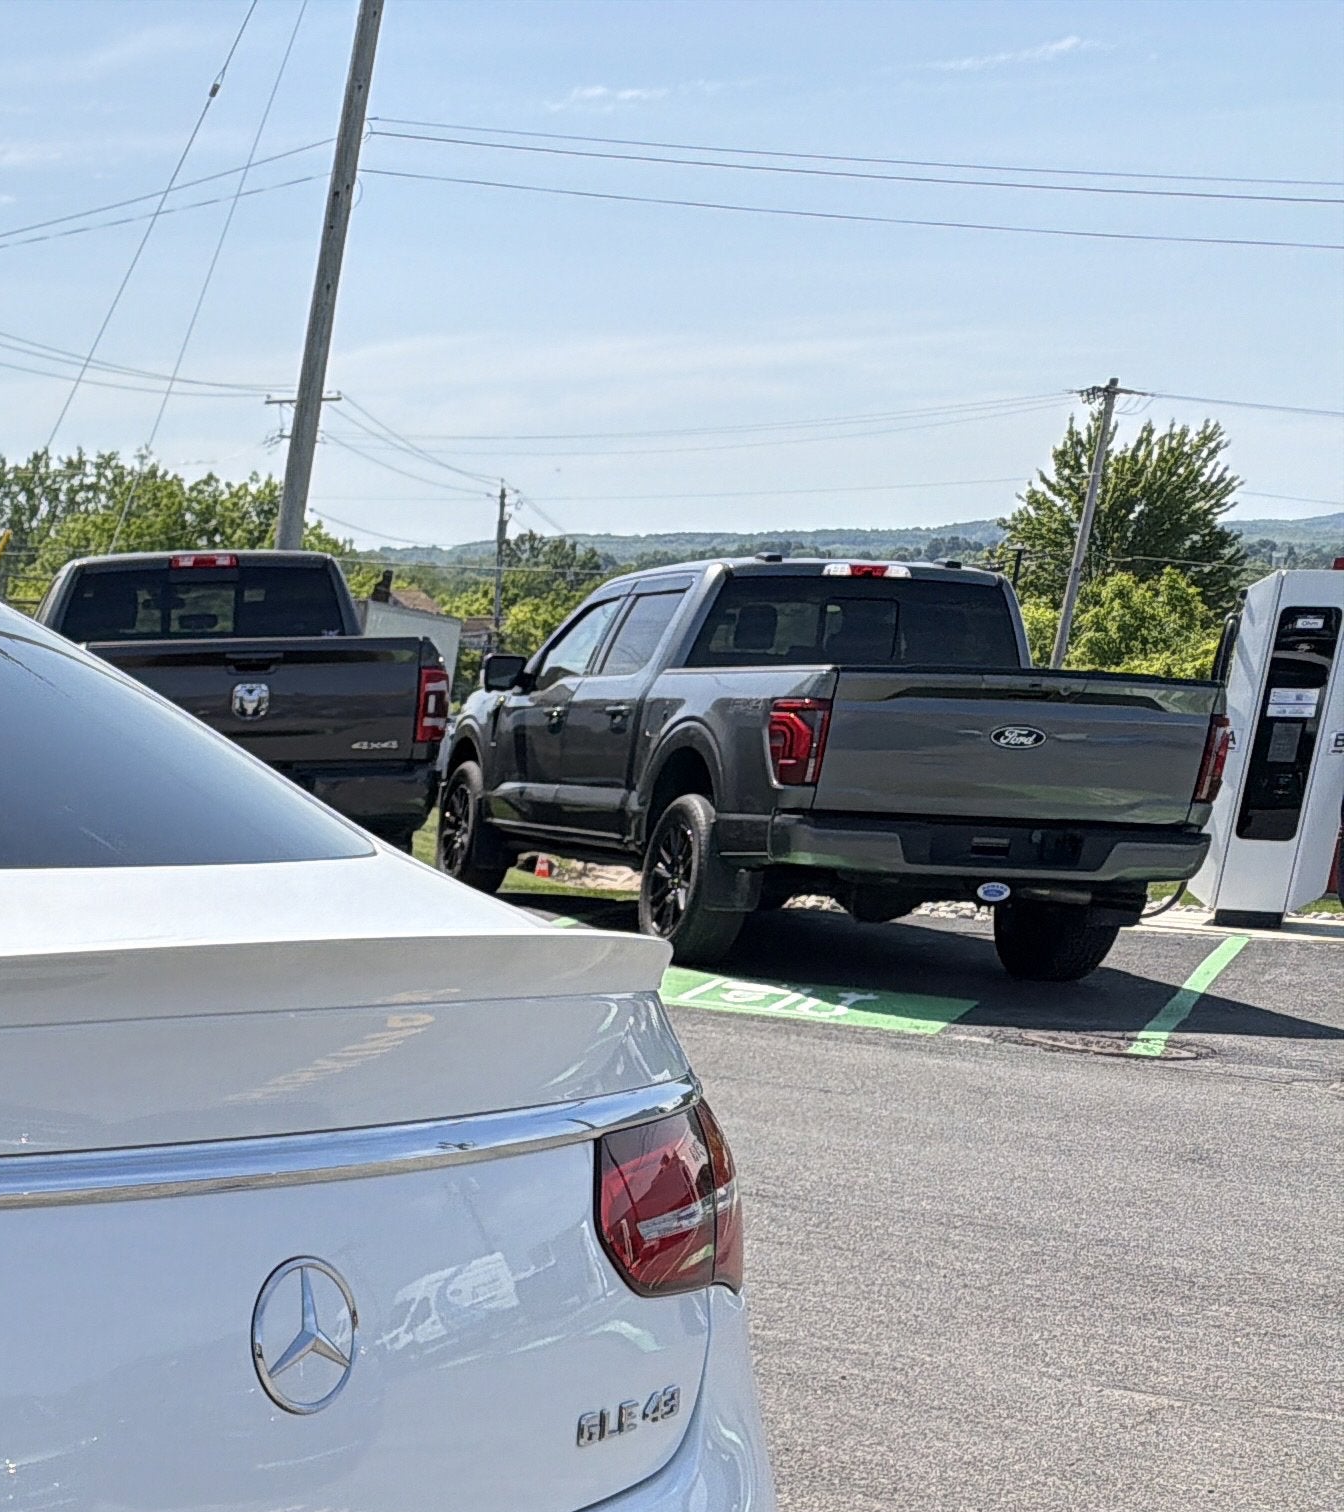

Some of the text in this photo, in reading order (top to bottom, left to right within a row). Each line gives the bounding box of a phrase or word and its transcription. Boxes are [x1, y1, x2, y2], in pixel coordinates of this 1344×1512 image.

[1000, 729, 1037, 745] Ford
[577, 1384, 681, 1447] GLE 43
